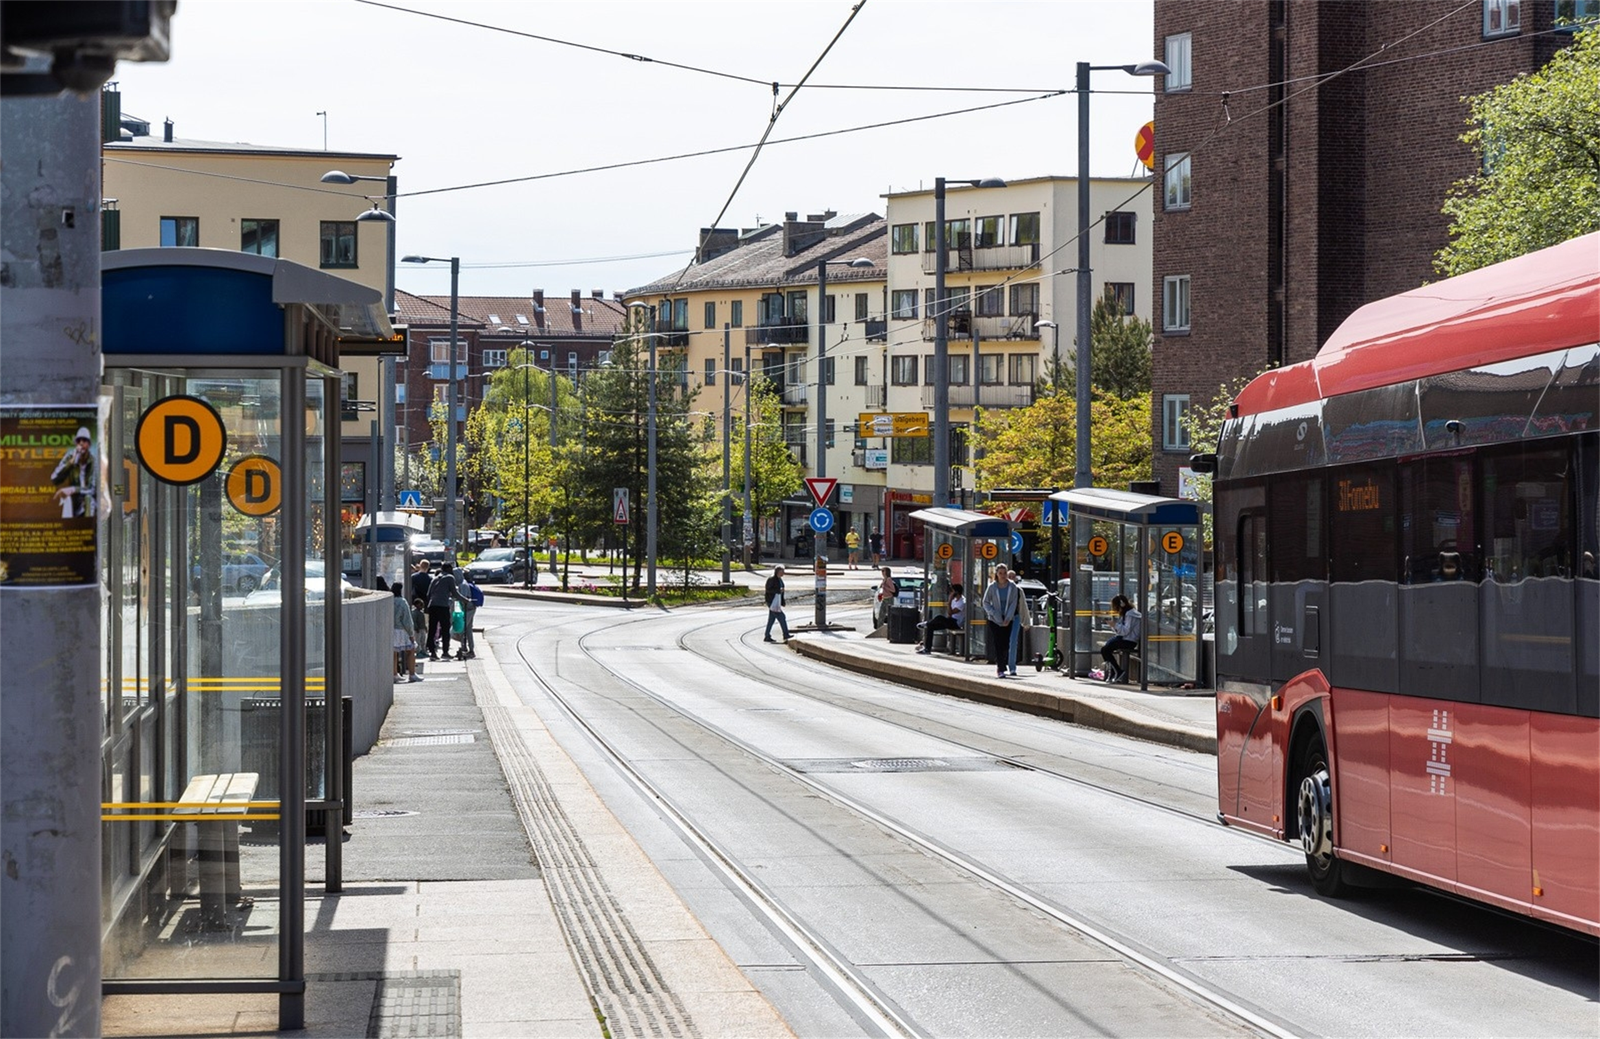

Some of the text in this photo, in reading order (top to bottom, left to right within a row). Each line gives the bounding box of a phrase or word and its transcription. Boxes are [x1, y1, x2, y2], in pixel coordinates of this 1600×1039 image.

[0, 434, 74, 446] MILLION
[164, 415, 201, 465] D
[245, 469, 271, 503] D
